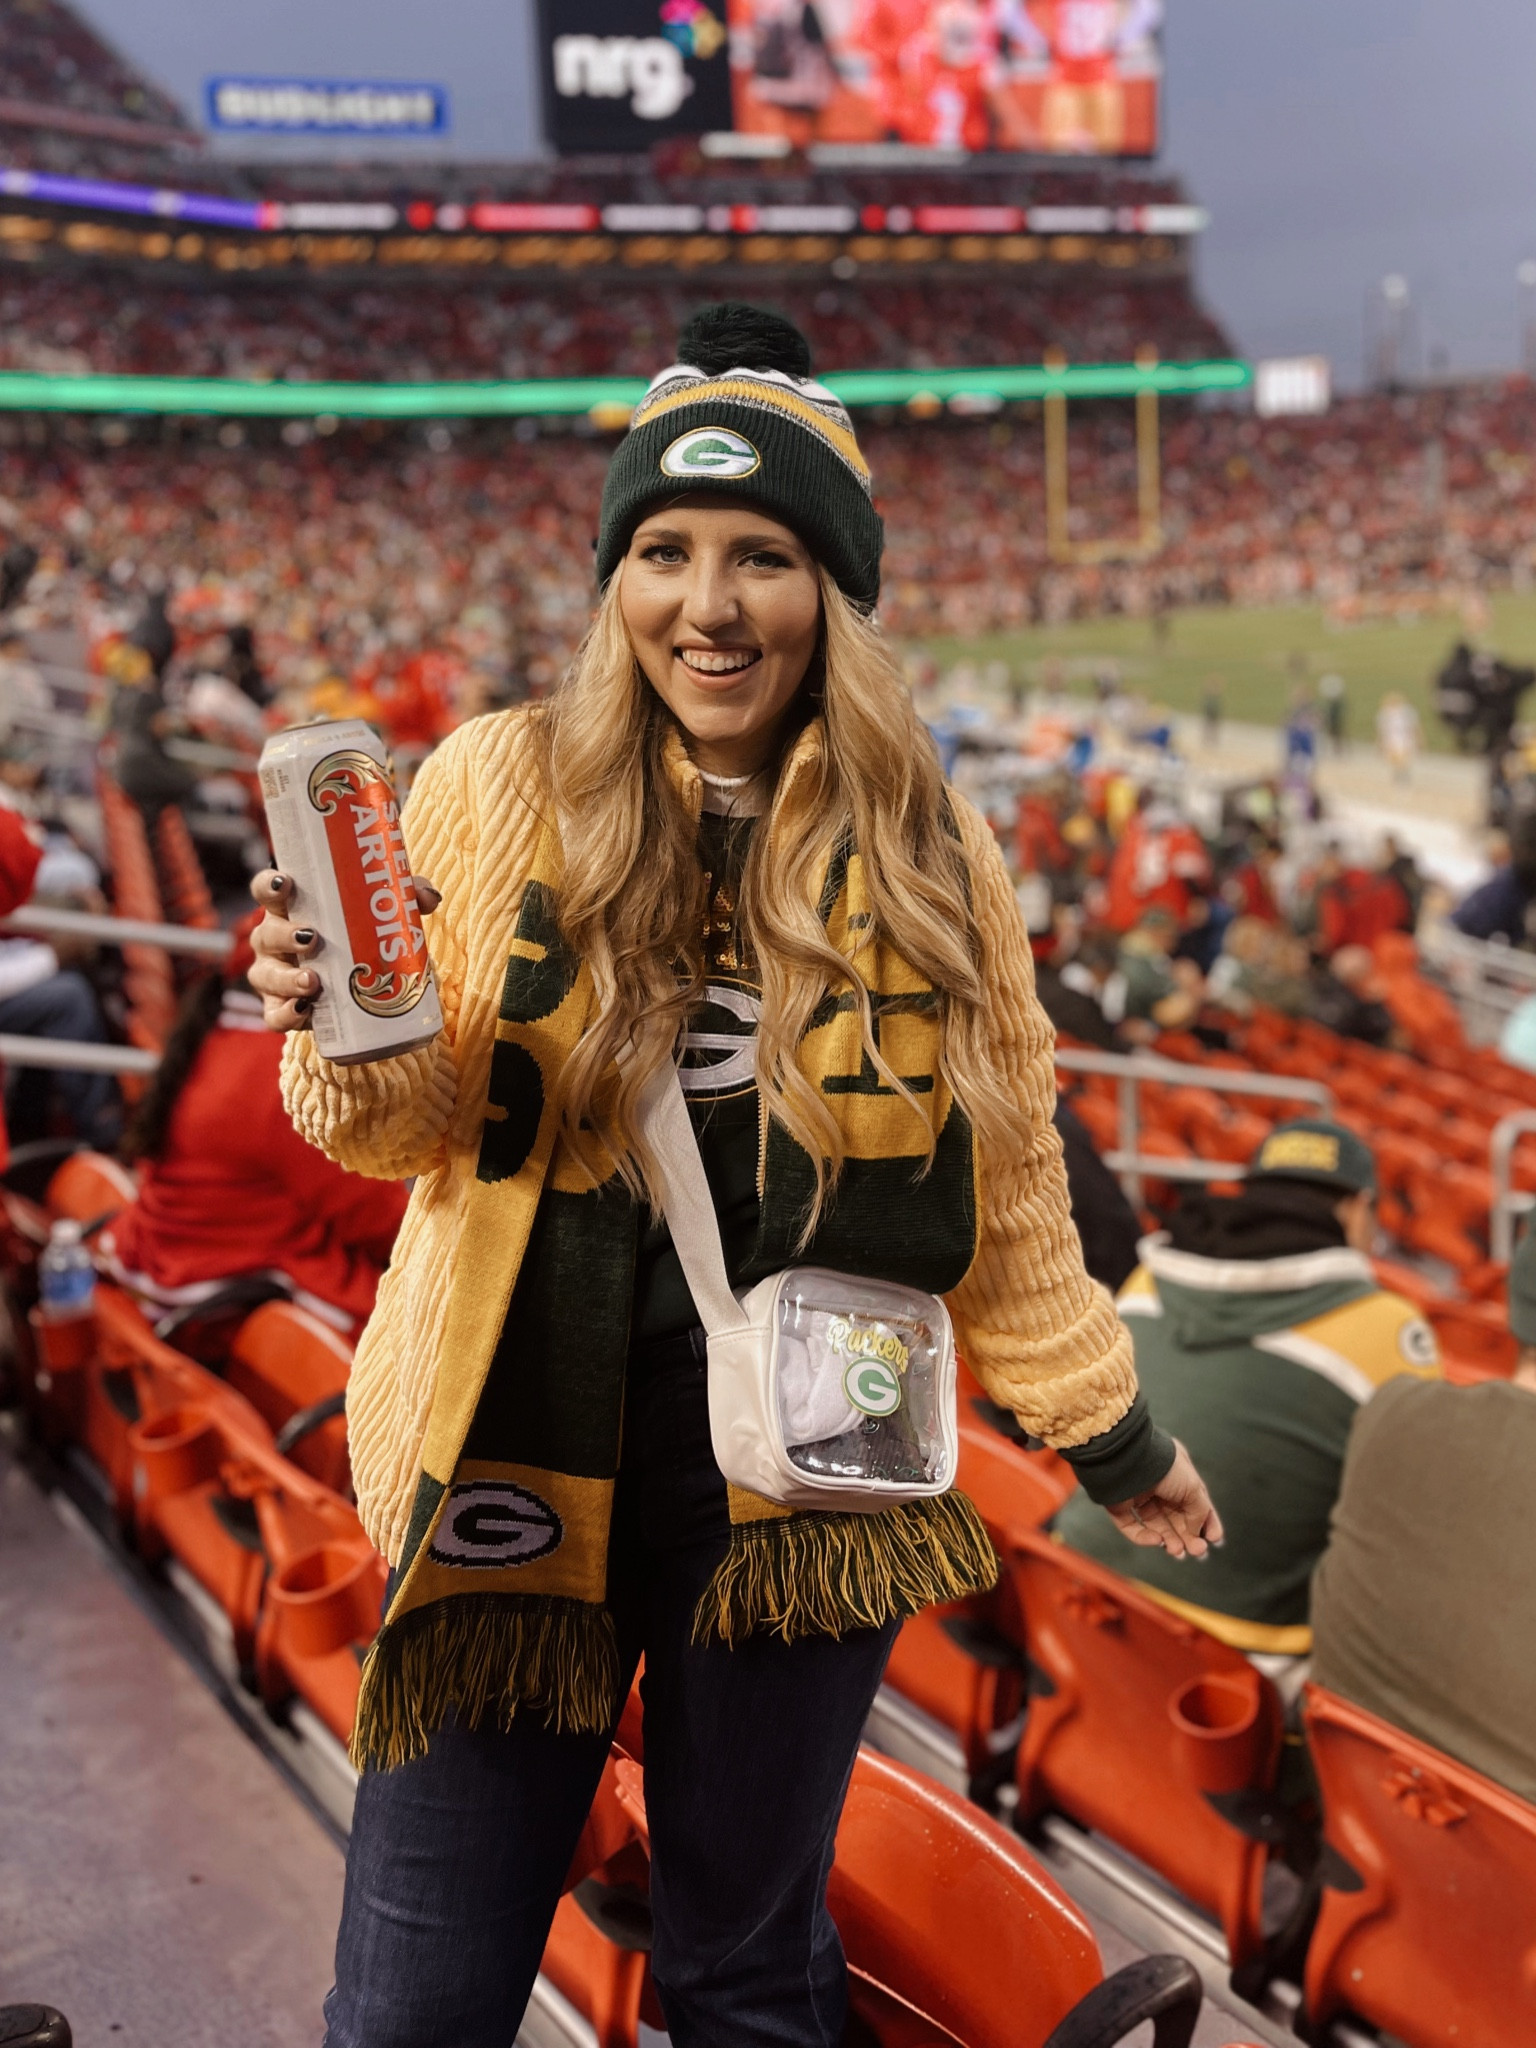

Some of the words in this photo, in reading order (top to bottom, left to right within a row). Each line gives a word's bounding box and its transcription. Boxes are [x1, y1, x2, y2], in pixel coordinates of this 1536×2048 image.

[552, 34, 684, 120] nrg
[664, 430, 757, 476] G
[349, 803, 408, 963] ARTOIS
[382, 801, 425, 954] STELLA
[826, 1317, 909, 1374] Packers
[845, 1359, 899, 1414] G
[430, 1488, 555, 1560] G
